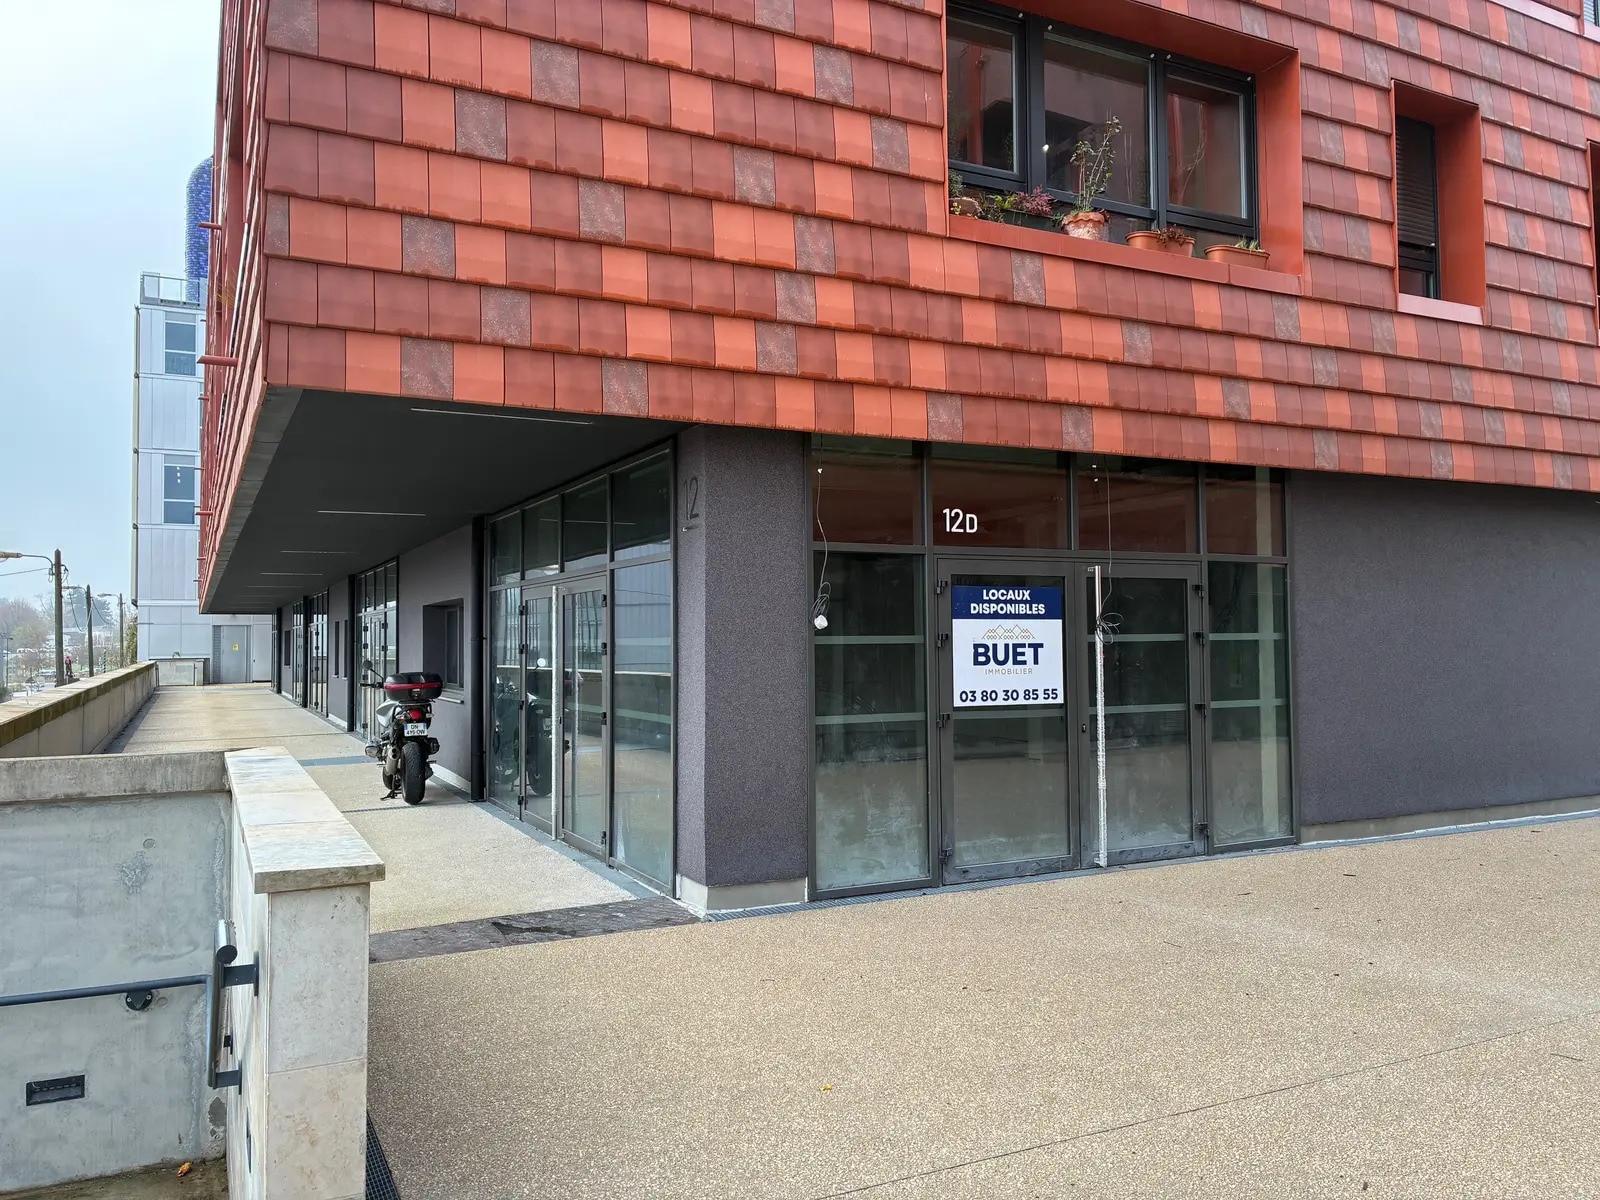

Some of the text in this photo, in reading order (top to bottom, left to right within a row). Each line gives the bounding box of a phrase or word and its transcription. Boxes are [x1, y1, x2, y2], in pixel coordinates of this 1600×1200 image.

[683, 476, 699, 520] 12
[942, 508, 978, 533] 12D
[982, 589, 1031, 601] LOCAUX
[970, 602, 1046, 615] DISPONIBLES
[972, 642, 1044, 667] BUET
[959, 687, 1058, 703] 03 80 30 85 55
